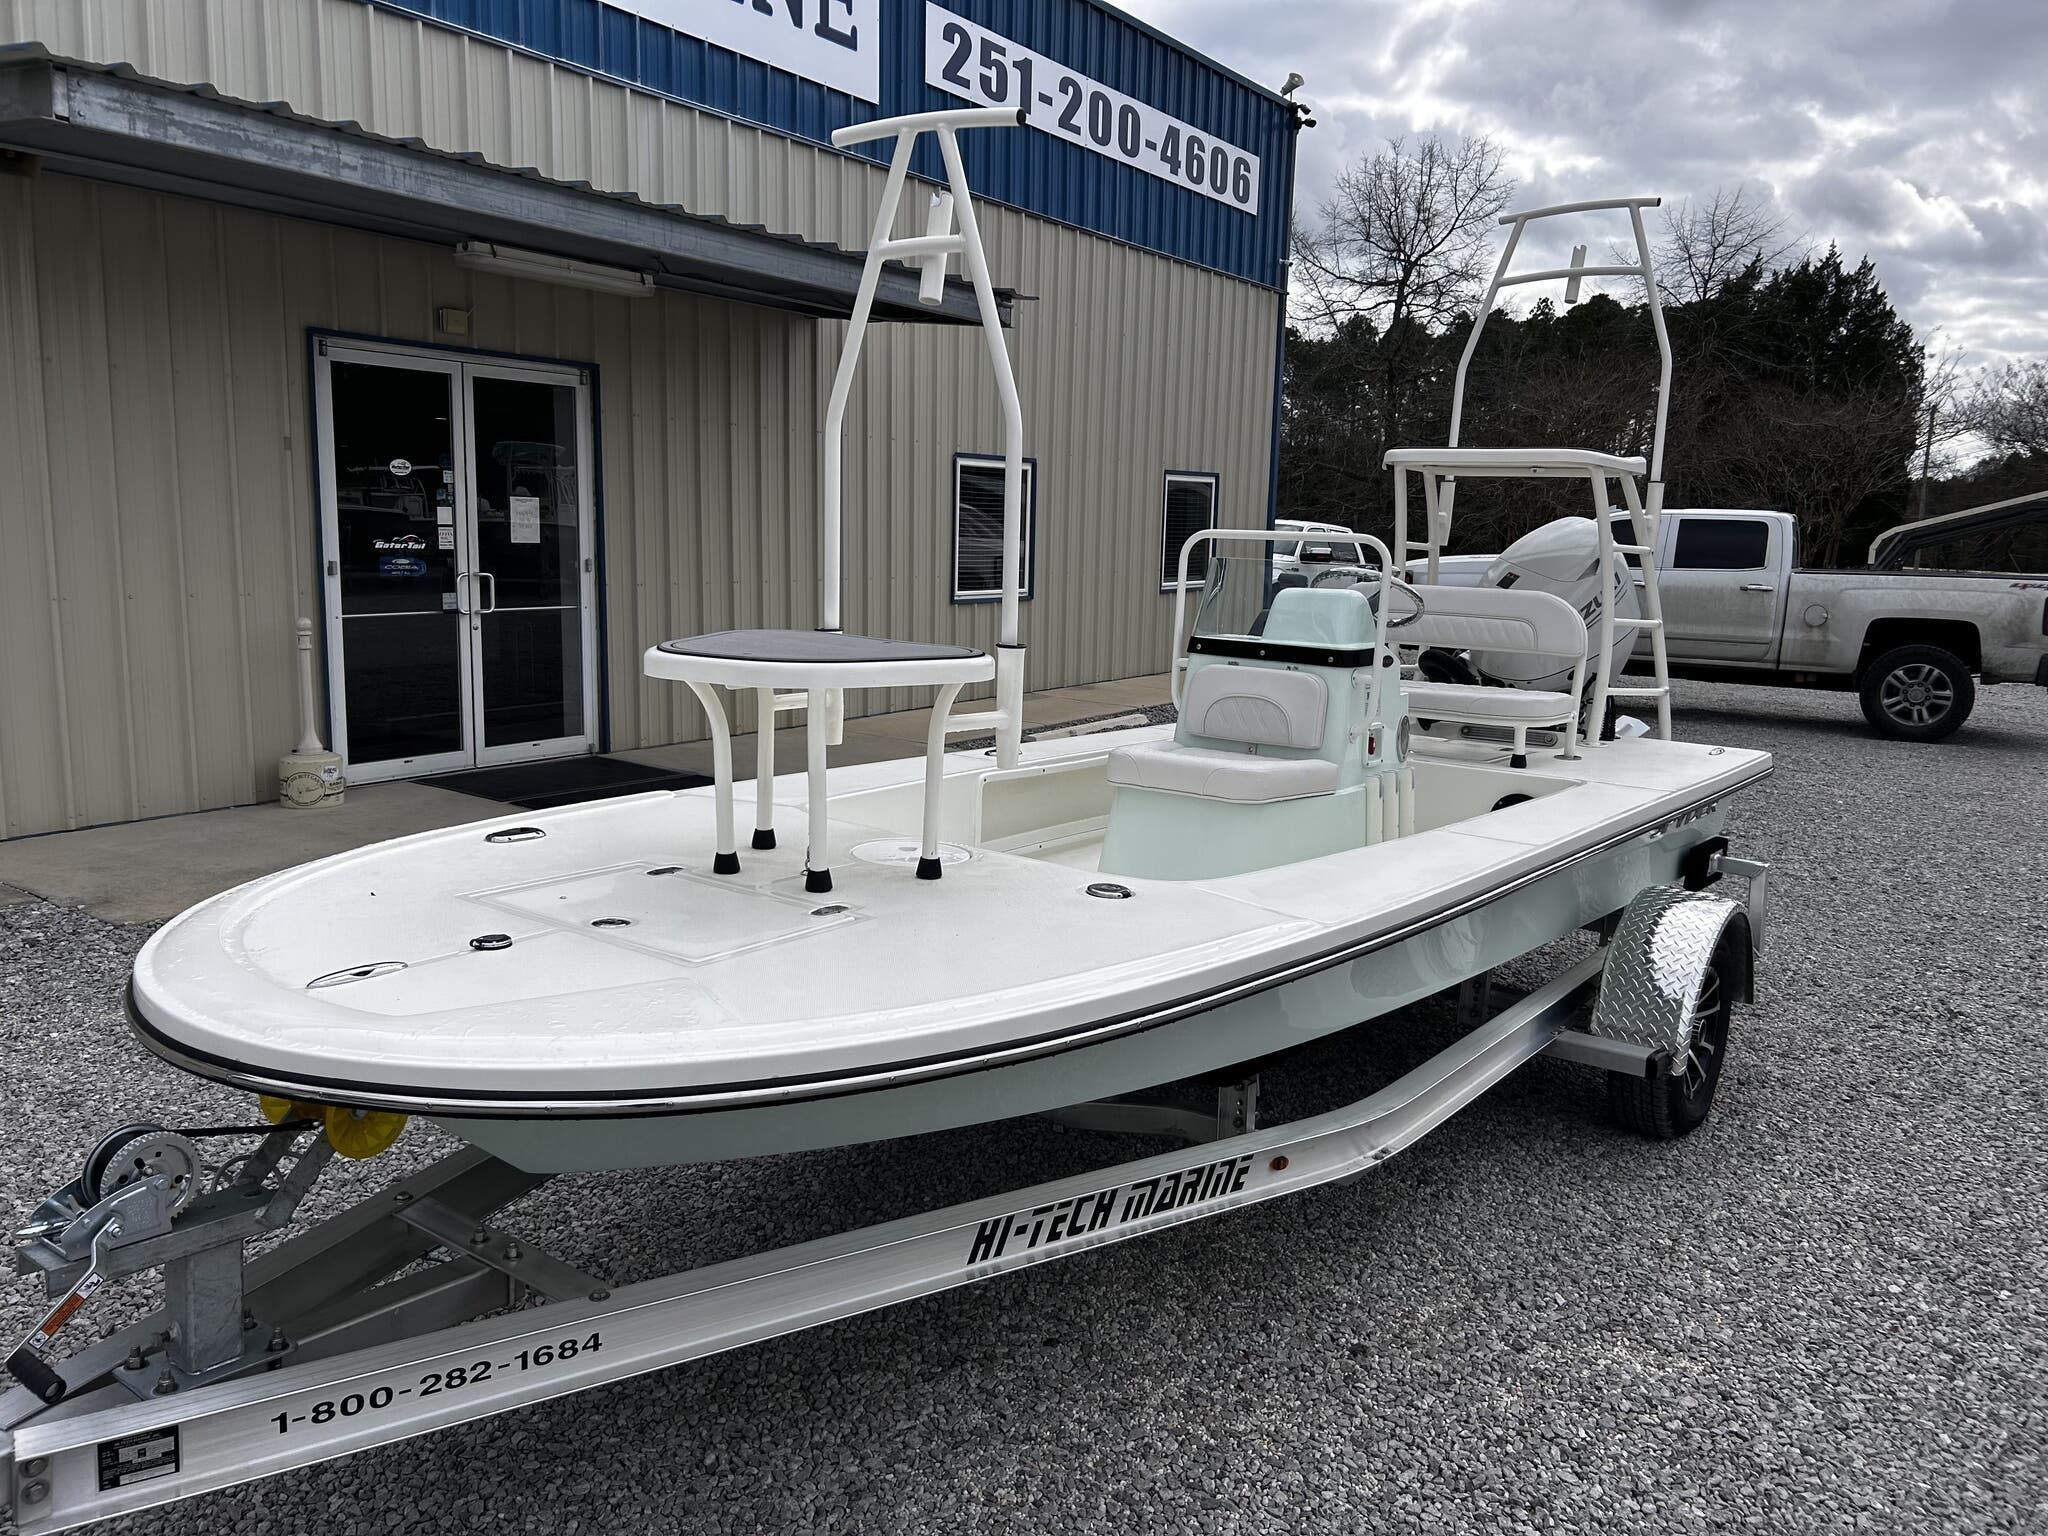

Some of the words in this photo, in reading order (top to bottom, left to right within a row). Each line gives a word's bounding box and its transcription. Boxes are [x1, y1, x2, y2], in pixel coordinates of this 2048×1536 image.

[942, 22, 1251, 205] 251-200-4606
[966, 1187, 1119, 1266] HI-TECH
[1119, 1153, 1255, 1224] MARINE
[270, 1332, 603, 1434] 1-800-282-1684
